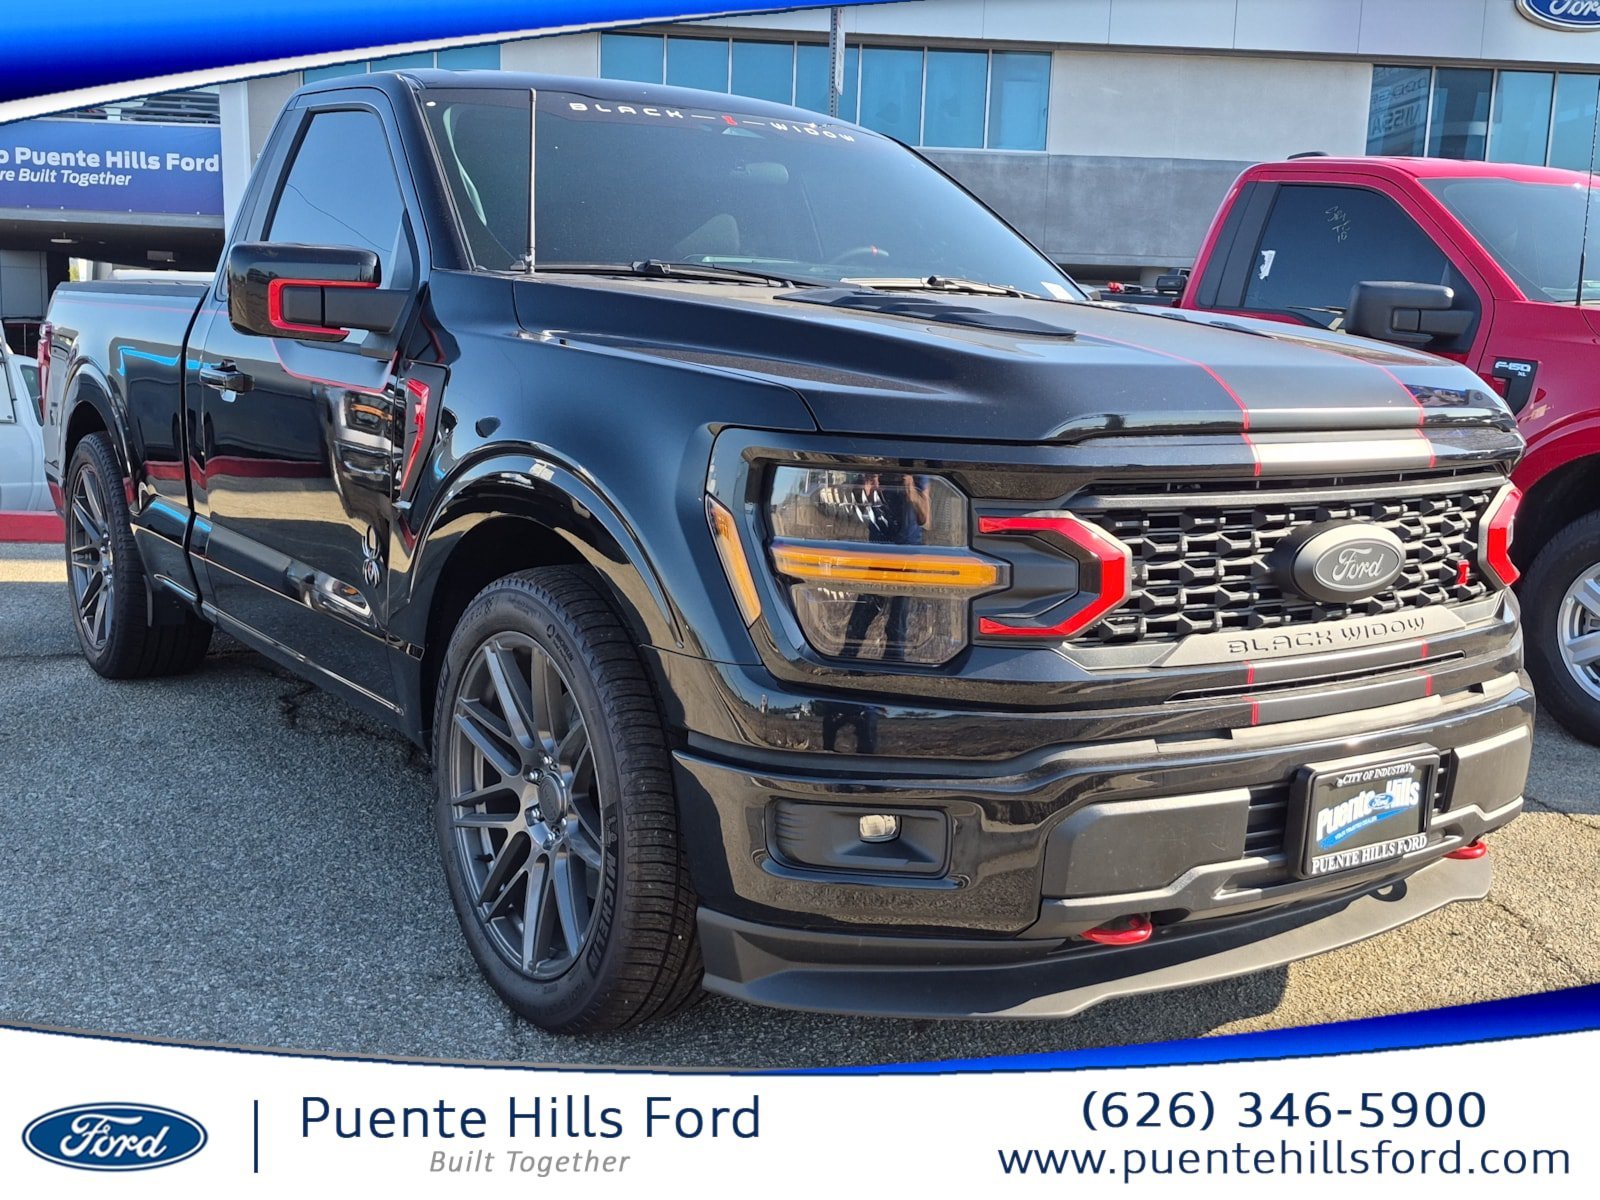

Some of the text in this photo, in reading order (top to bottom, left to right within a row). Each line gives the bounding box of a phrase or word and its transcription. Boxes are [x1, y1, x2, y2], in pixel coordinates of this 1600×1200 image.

[569, 102, 855, 143] BLACK WIDOW
[15, 146, 100, 168] Puente
[106, 151, 161, 170] Hills
[166, 153, 219, 172] Ford
[18, 168, 56, 183] Built
[61, 170, 132, 186] Together
[1495, 361, 1531, 373] F-150
[1332, 547, 1385, 582] Ford
[1227, 615, 1425, 654] BLACK WIDOW
[1342, 763, 1411, 785] CITY OF INDUSTRY
[1316, 789, 1377, 842] Puente
[1386, 777, 1420, 809] Hills
[1311, 835, 1428, 875] PUENTE HILLS FORD
[588, 853, 616, 974] MICHELIN
